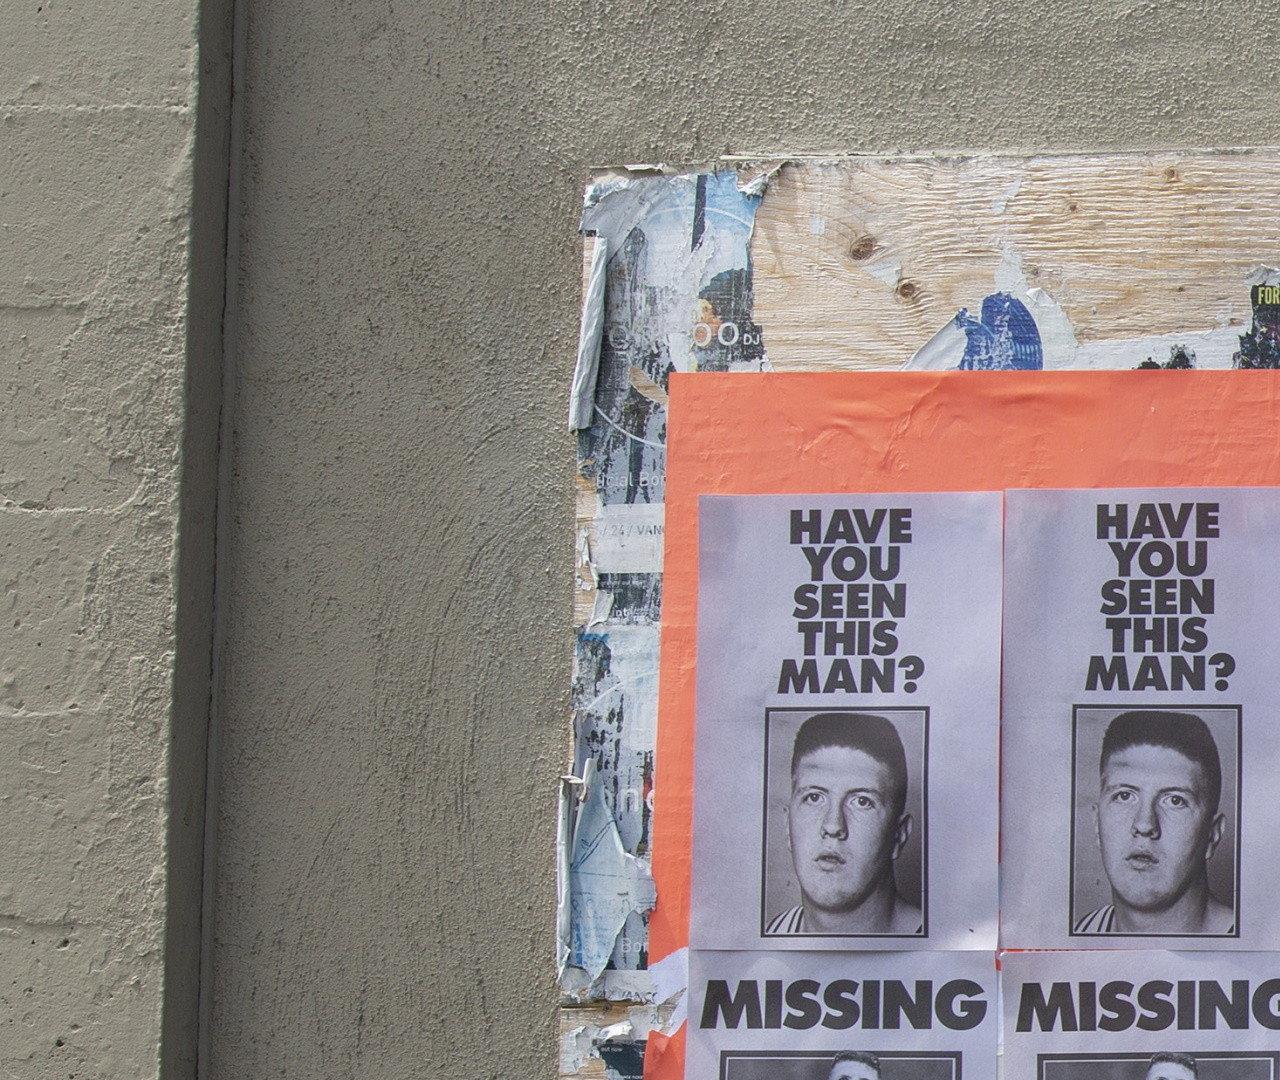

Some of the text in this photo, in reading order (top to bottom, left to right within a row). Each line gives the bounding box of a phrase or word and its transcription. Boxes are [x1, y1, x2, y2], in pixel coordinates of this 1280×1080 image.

[637, 524, 662, 536] VAN
[790, 509, 911, 544] HAVE
[1097, 503, 1219, 539] HAVE
[802, 546, 900, 581] YOU
[1108, 541, 1207, 577] YOU
[793, 584, 906, 619] SEEN
[1100, 579, 1214, 615] SEEN
[798, 621, 898, 655] THIS
[1106, 617, 1208, 653] THIS
[778, 656, 924, 693] MAN?
[1085, 653, 1235, 691] MAN?
[700, 979, 987, 1030] MISSING
